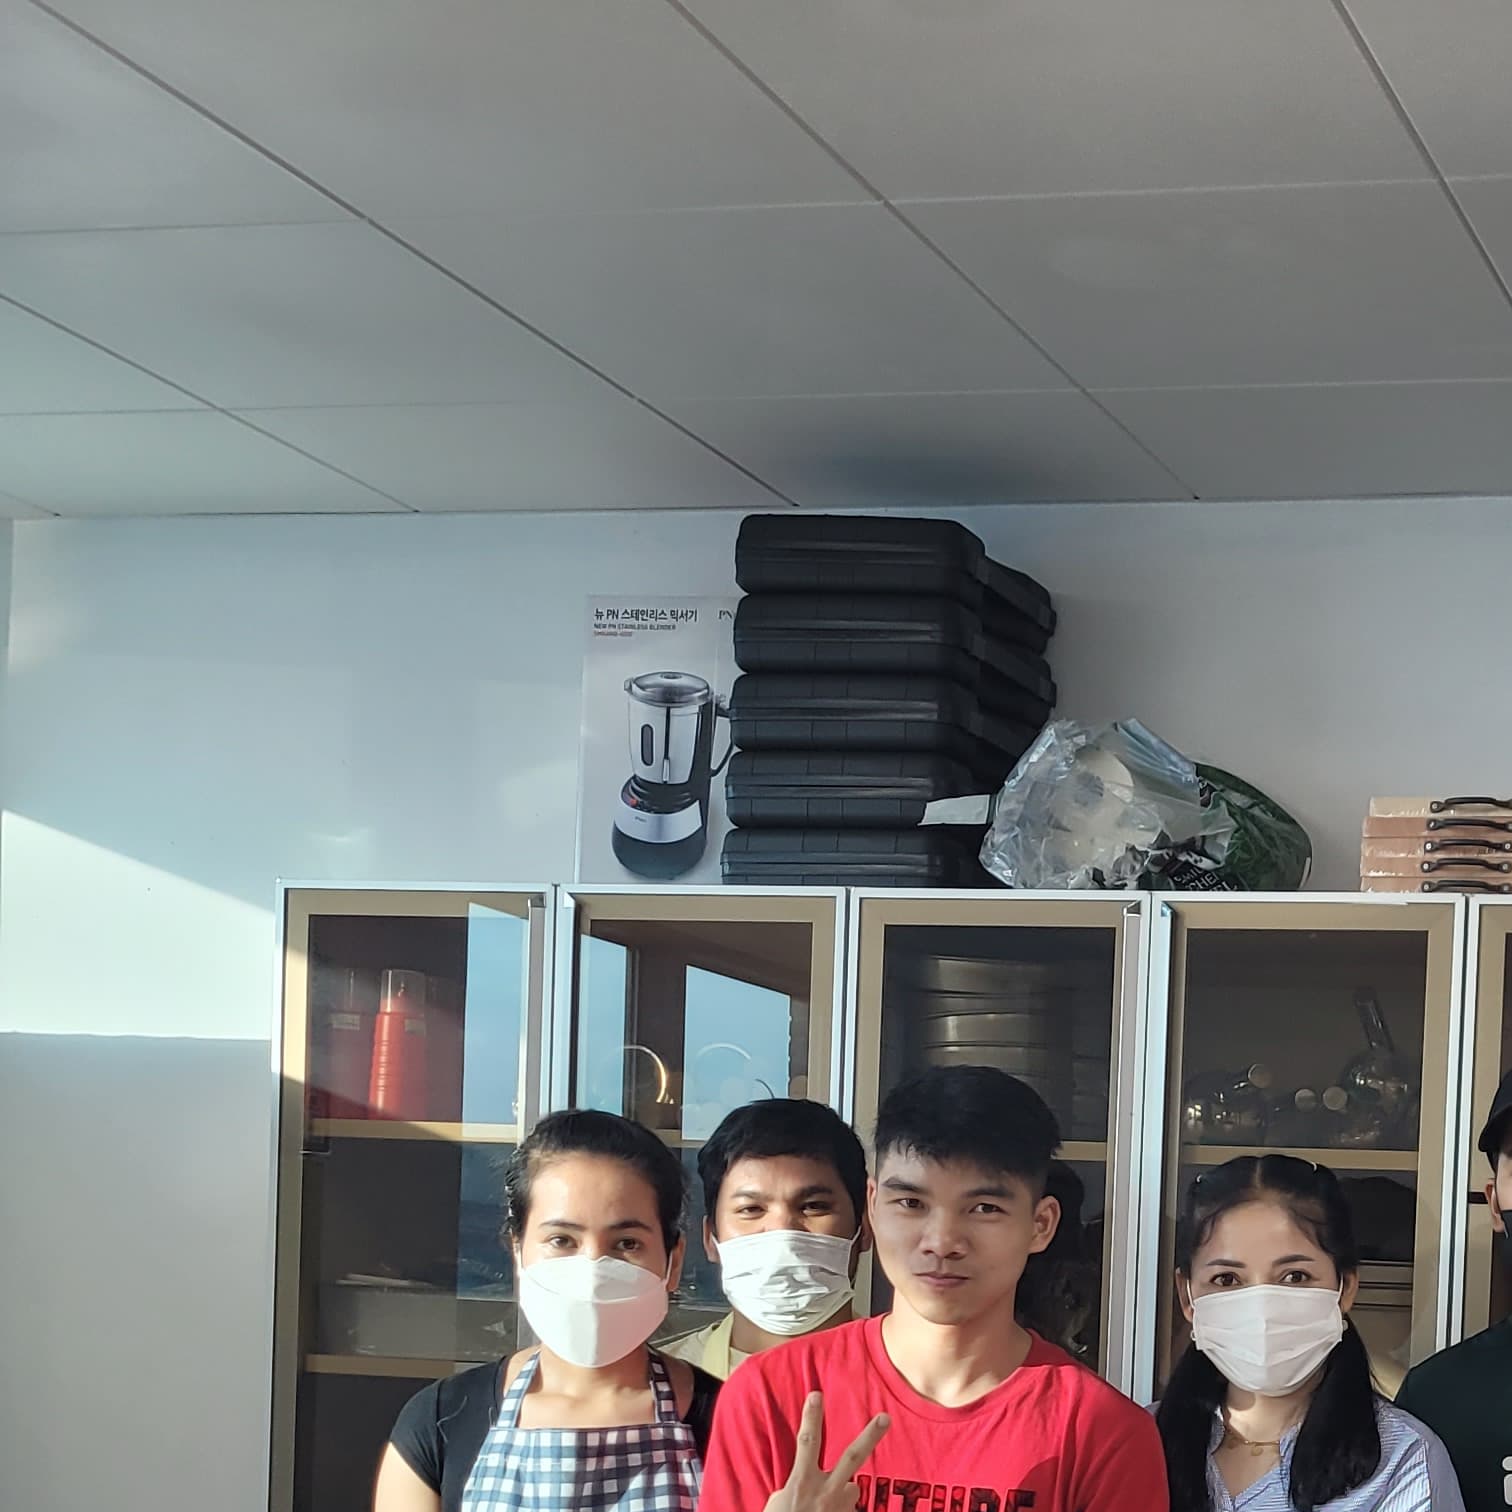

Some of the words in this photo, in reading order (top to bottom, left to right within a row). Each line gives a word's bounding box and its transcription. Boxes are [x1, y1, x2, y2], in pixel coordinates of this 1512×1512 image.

[594, 608, 605, 620] 뉴
[606, 609, 619, 620] PN
[621, 608, 668, 622] 스테인리스
[670, 608, 698, 623] 믹서기
